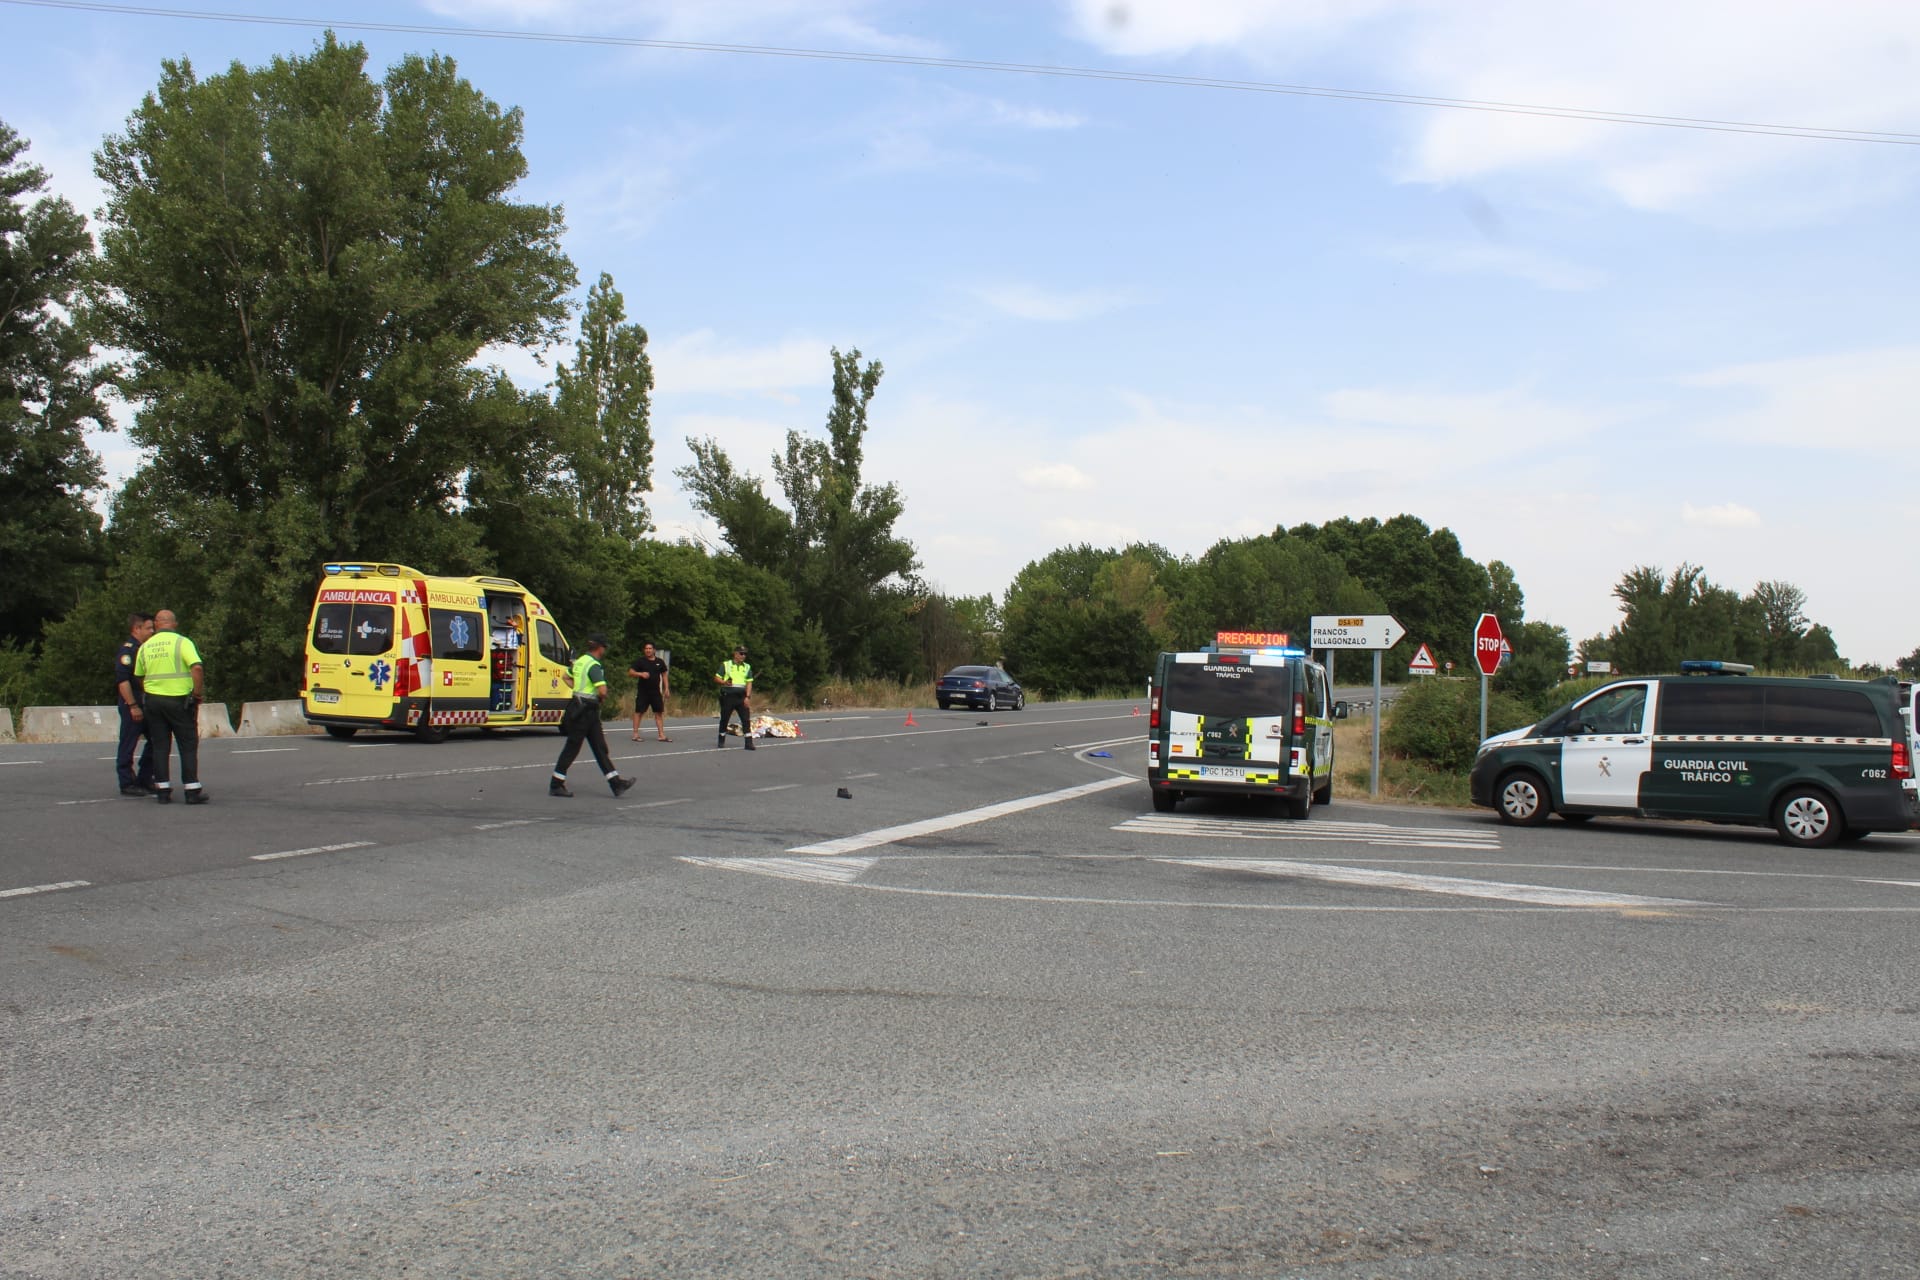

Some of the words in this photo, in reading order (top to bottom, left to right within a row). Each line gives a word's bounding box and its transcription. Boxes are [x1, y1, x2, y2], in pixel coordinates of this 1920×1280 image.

[323, 591, 391, 603] AMBULANCIA
[430, 593, 478, 606] AMBULANCIA
[1313, 628, 1348, 636] FRANCOS
[1385, 628, 1390, 636] 2
[1217, 631, 1288, 646] PRECAUCION
[1313, 637, 1367, 645] VILLAGONZALO
[1479, 637, 1499, 652] STOP
[1664, 759, 1715, 770] GUARDIA
[1718, 760, 1749, 771] CIVIL
[1680, 770, 1731, 783] TRÁFICO
[1868, 769, 1887, 779] 062
